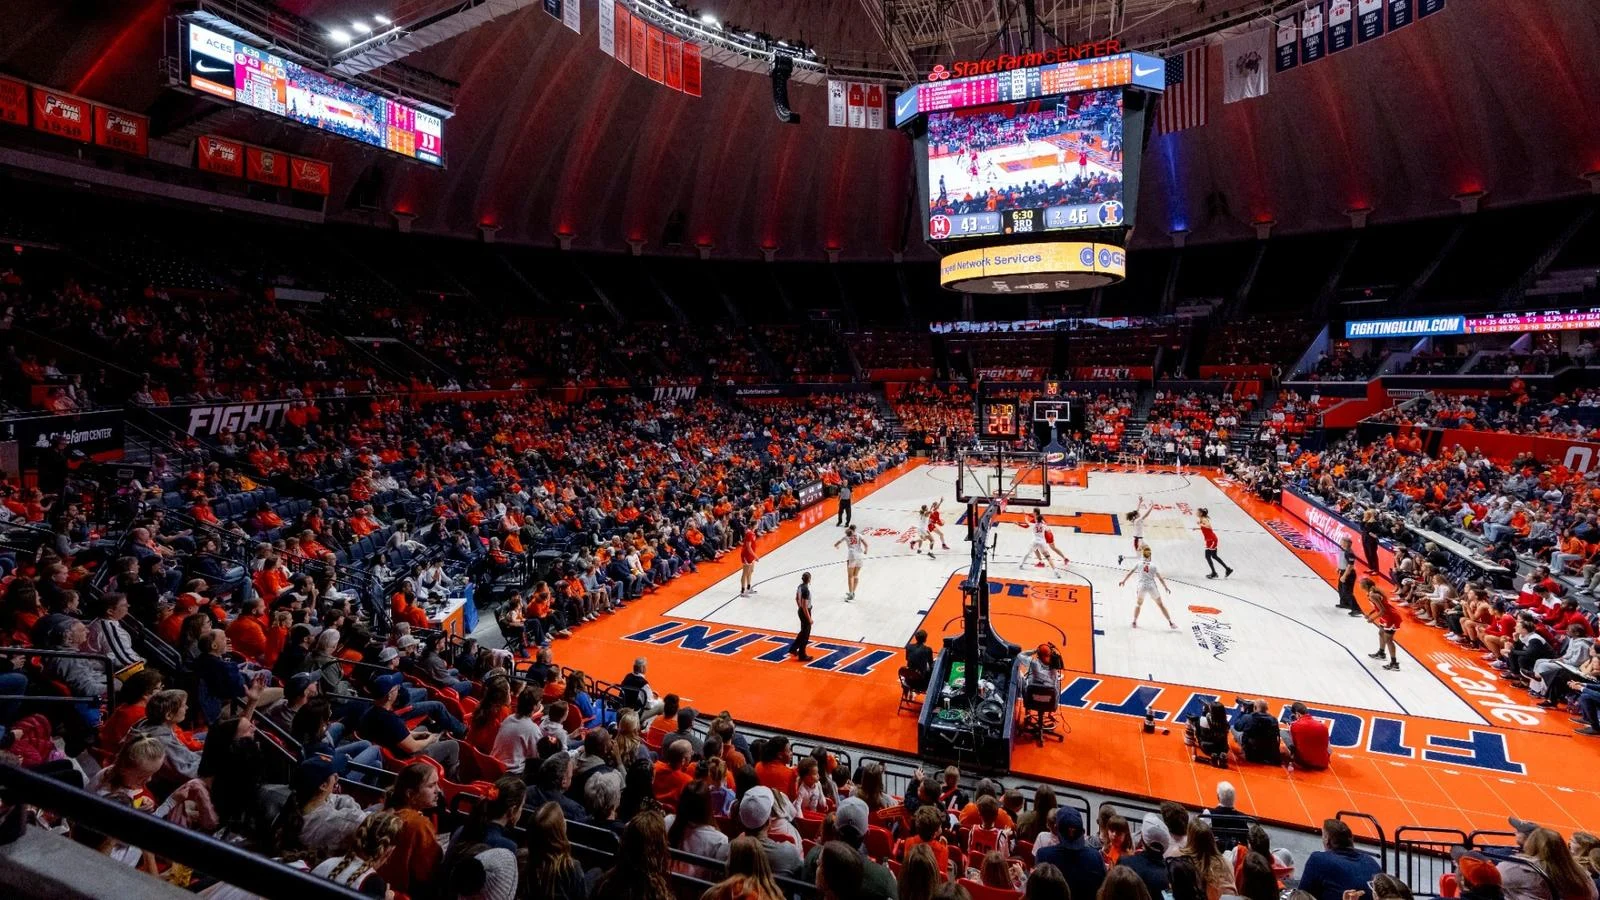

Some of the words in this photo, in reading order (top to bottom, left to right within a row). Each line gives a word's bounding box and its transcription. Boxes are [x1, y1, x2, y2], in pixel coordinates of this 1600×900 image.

[206, 38, 232, 54] ACES
[1044, 39, 1120, 64] CENTER
[1012, 210, 1034, 220] 6:30
[1013, 219, 1033, 227] 3RD
[1069, 207, 1088, 224] 46
[961, 216, 978, 232] 43
[957, 257, 991, 270] Network
[994, 254, 1042, 265] Services
[1350, 318, 1460, 335] FIGHTINGILLINI.COM
[989, 415, 1011, 434] 20
[89, 428, 113, 441] CENTER
[620, 621, 899, 677] ILLINI
[1427, 651, 1547, 726] Carle
